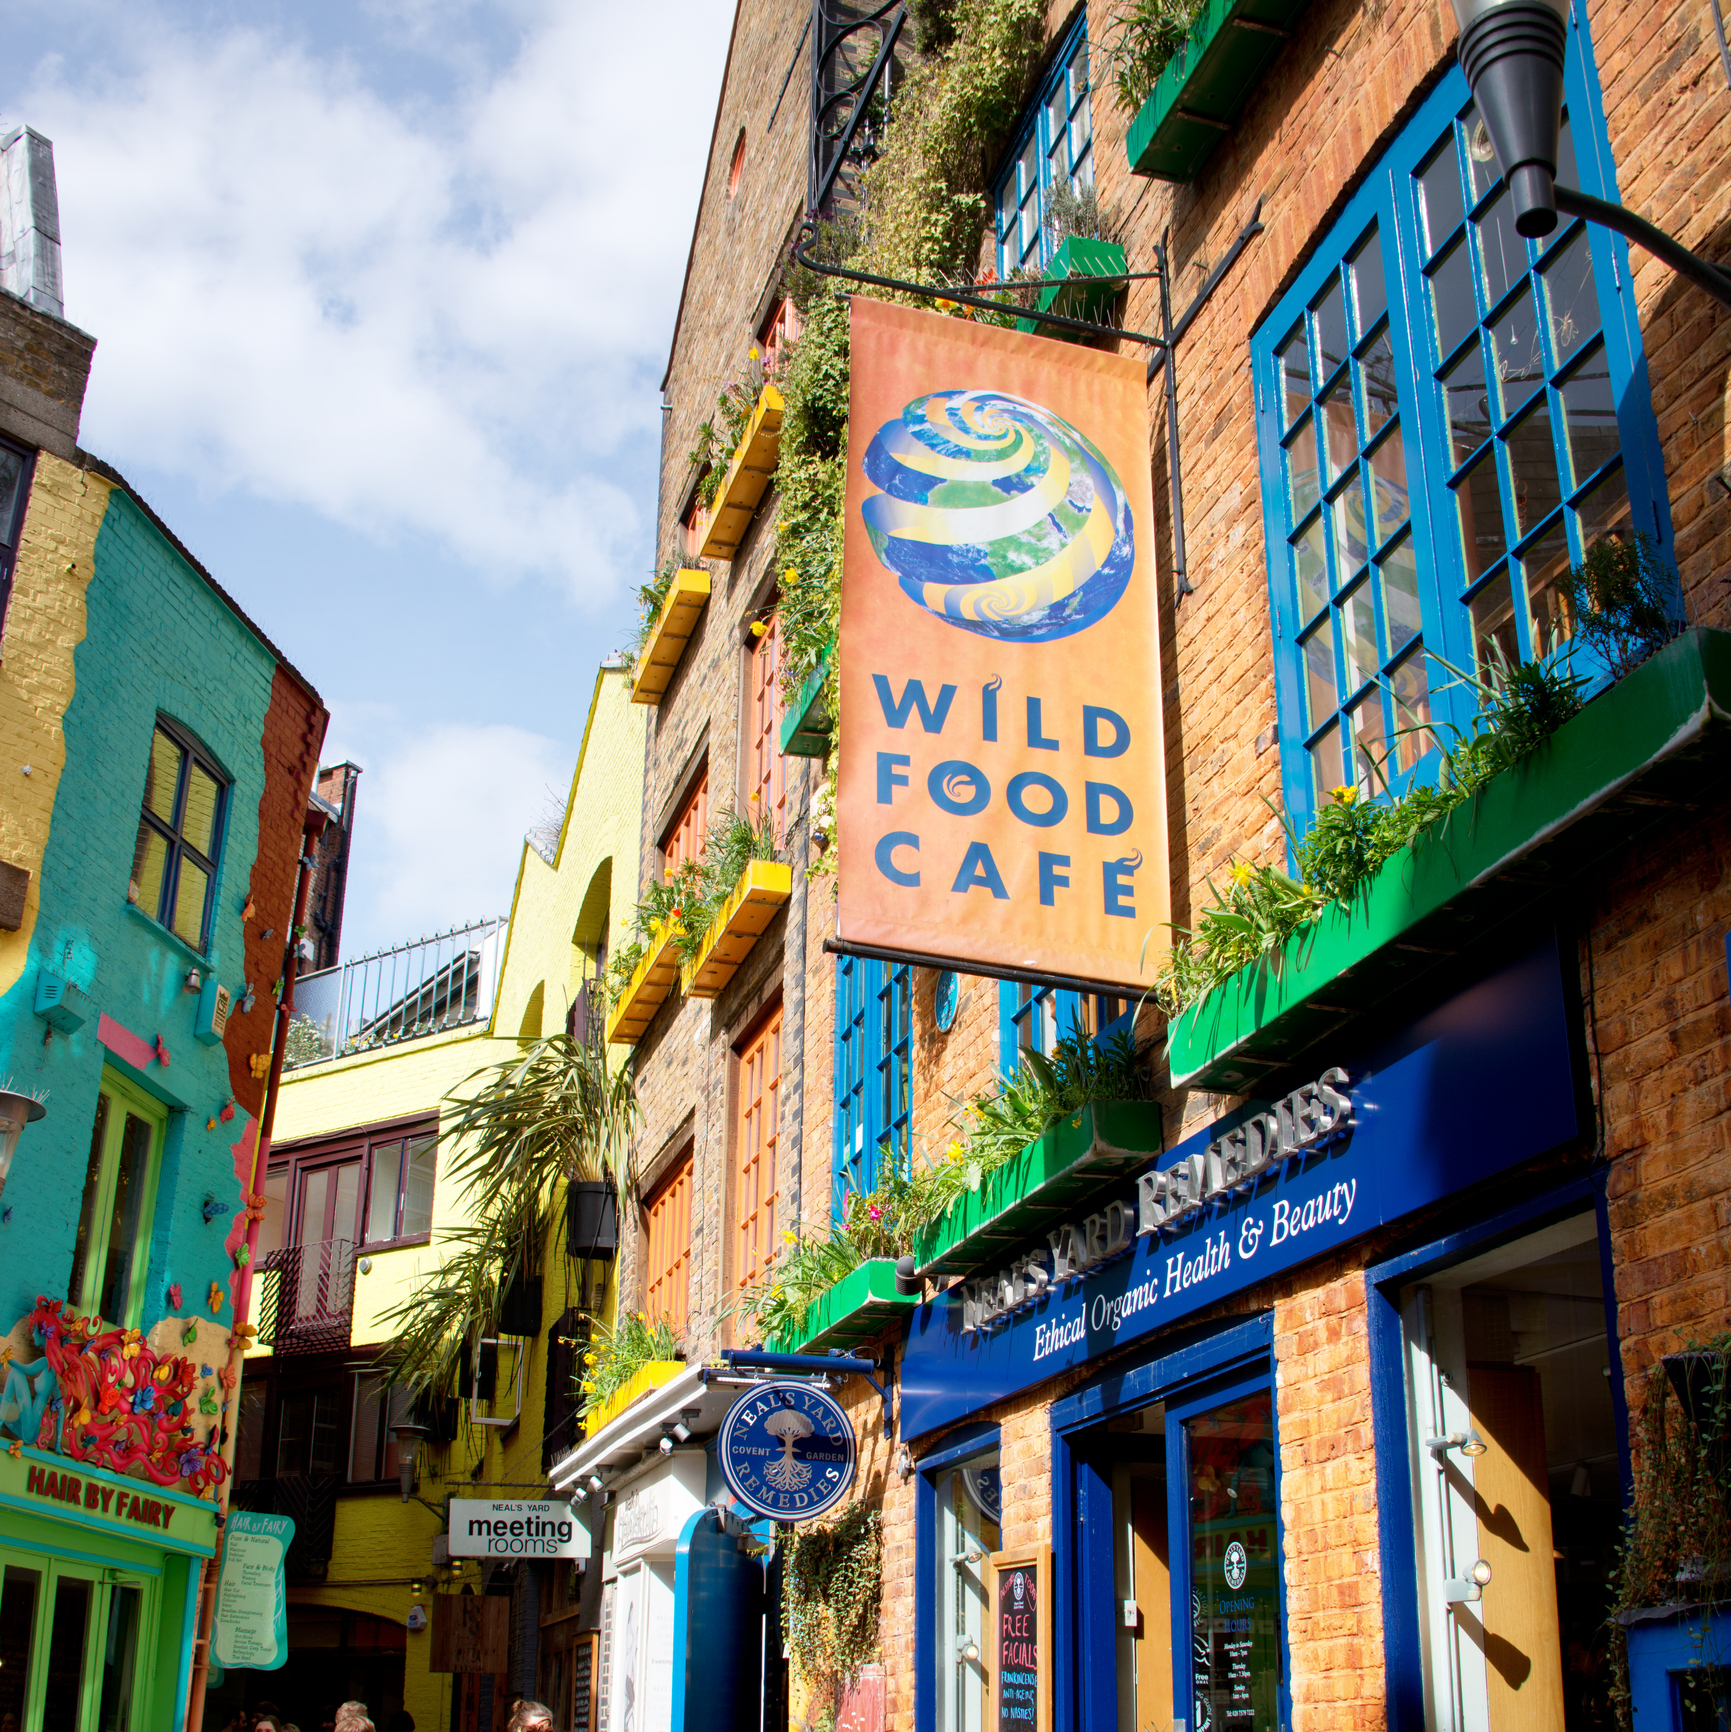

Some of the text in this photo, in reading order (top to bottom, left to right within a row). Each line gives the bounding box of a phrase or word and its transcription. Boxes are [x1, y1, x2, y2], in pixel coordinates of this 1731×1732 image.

[872, 673, 1131, 759] WILD
[877, 751, 1134, 836] FOOD
[960, 1066, 1352, 1335] NEAL'S YARD REMEDIES
[1033, 1178, 1357, 1361] Ethical Organic Health & Beauty
[733, 1392, 844, 1446] NEAL'S YARD
[732, 1446, 845, 1462] COVENT GARDEN
[28, 1465, 176, 1529] HAIR BY FAIRY
[735, 1467, 840, 1508] REMEDIES
[492, 1504, 550, 1512] NEAL'S YARD
[230, 1513, 251, 1531] HAIR
[260, 1518, 288, 1534] FAIRY
[468, 1515, 573, 1543] meeting
[250, 1536, 270, 1544] Natural
[487, 1538, 558, 1553] rooms
[262, 1565, 276, 1573] Body
[224, 1579, 236, 1587] Hair
[1219, 1597, 1255, 1614] OPENING
[234, 1627, 257, 1635] Massage
[1003, 1613, 1031, 1638] FREE
[1224, 1617, 1252, 1633] HOURS
[1002, 1641, 1037, 1670] FACIALS
[1001, 1706, 1035, 1725] NO NASTIES!
